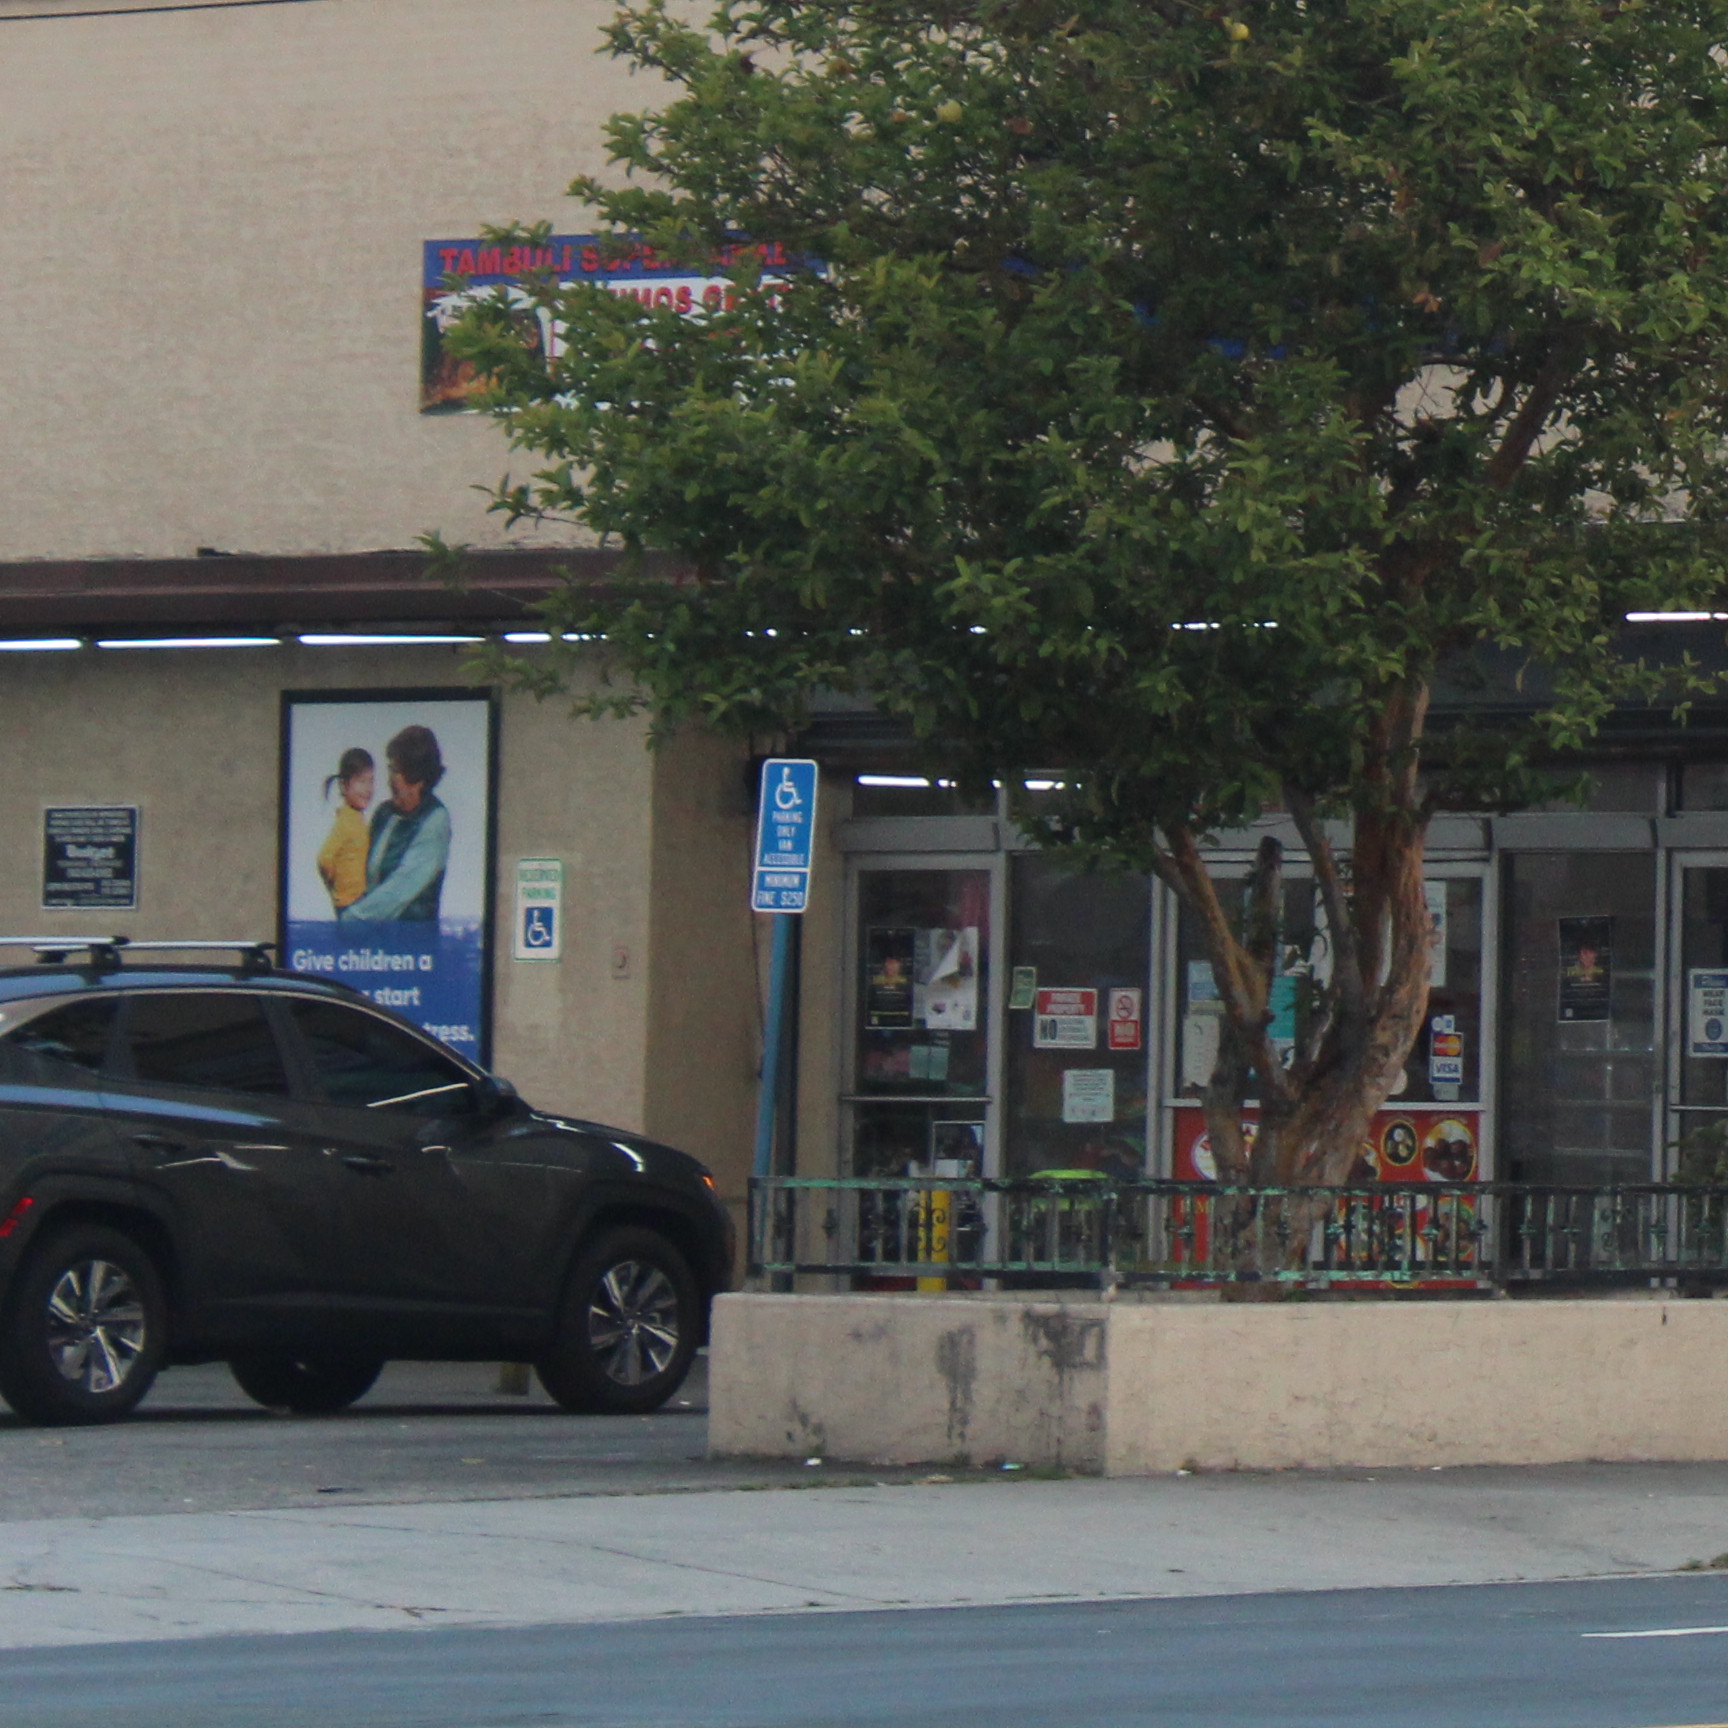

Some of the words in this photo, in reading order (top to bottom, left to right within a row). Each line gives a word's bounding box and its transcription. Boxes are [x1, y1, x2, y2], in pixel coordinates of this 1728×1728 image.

[440, 245, 571, 275] TAMBULI
[764, 874, 801, 888] MINIMUM
[757, 890, 776, 906] FINE
[780, 890, 804, 907] $250
[292, 948, 335, 971] Give
[338, 948, 415, 972] children
[418, 955, 433, 972] a
[373, 985, 421, 1007] start
[1435, 1062, 1460, 1074] VISA
